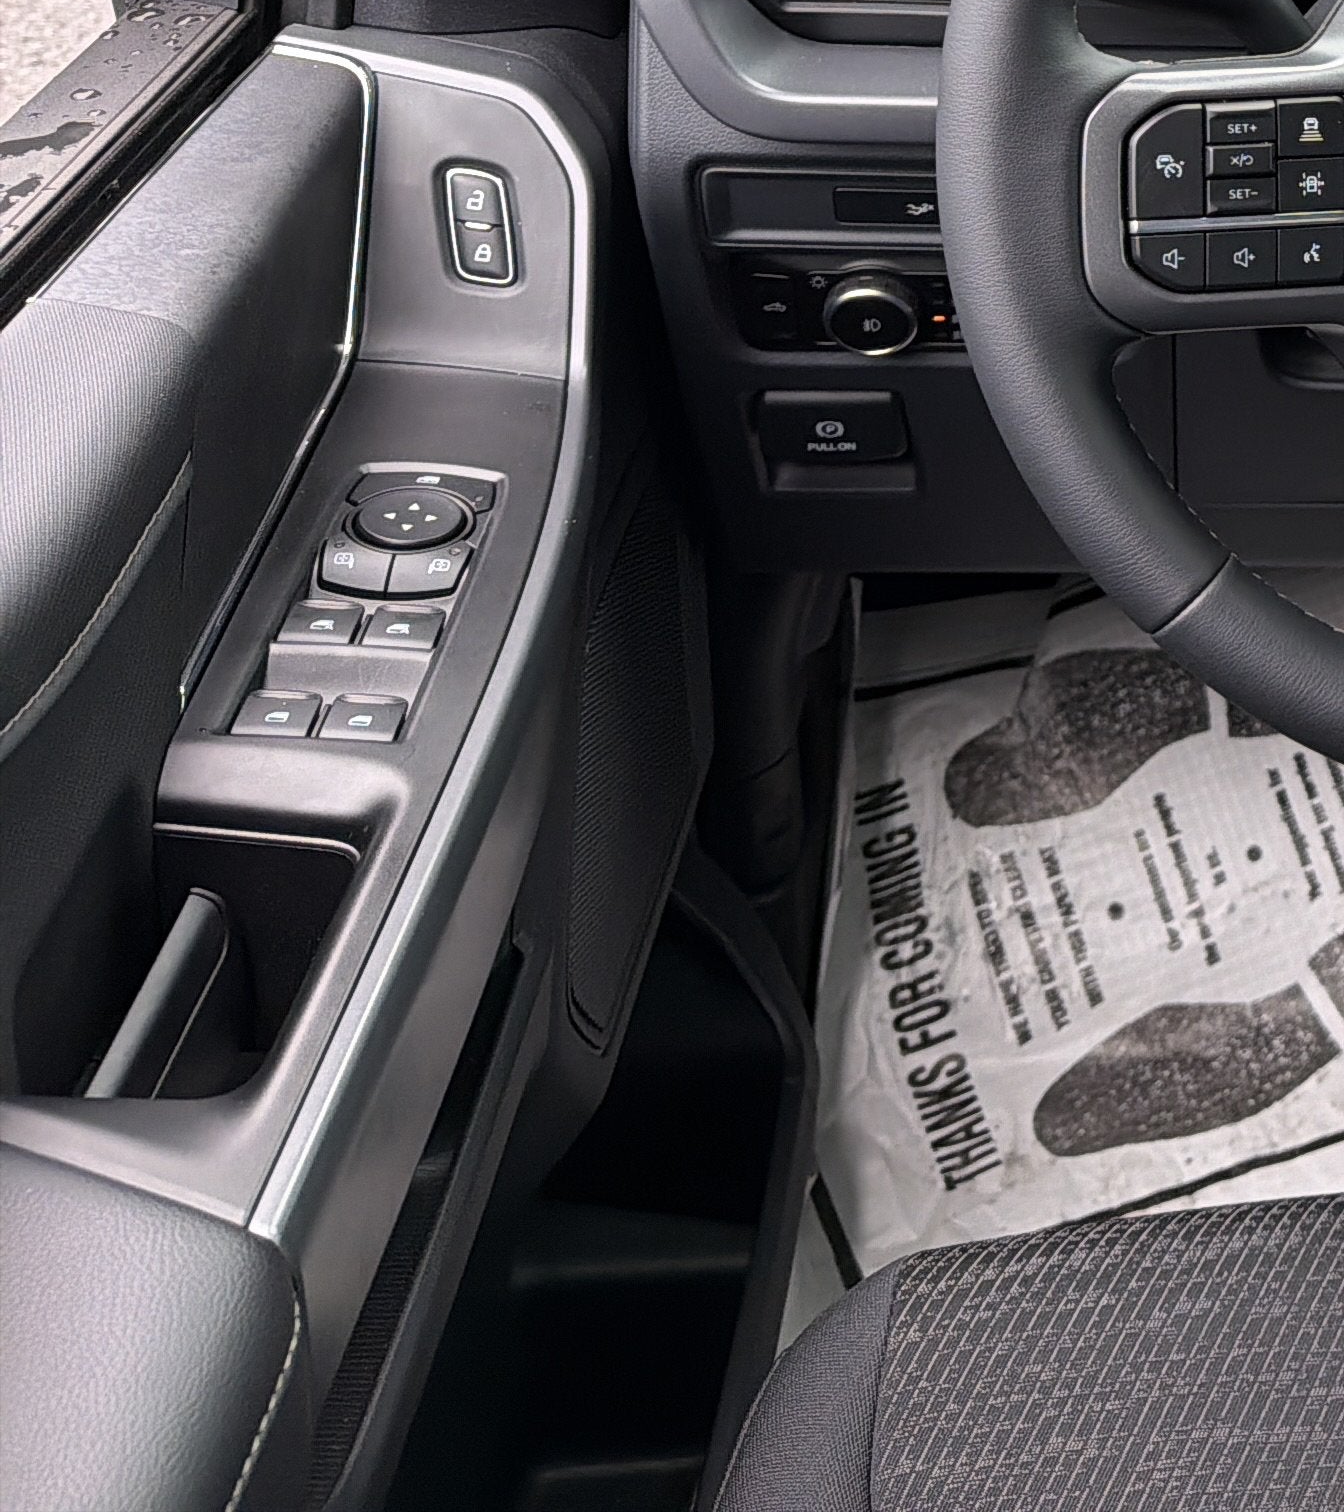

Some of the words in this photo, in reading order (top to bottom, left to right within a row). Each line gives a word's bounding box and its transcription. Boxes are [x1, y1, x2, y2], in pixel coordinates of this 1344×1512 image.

[1227, 122, 1258, 135] SET+
[807, 442, 836, 453] PULL
[836, 441, 857, 452] ON
[1266, 766, 1283, 788] for
[854, 777, 911, 827] IN
[1152, 791, 1183, 838] people
[1275, 787, 1313, 868] suggestions
[1000, 850, 1029, 902] CLEAN
[1038, 845, 1062, 879] MAT
[1168, 838, 1200, 905] important
[1304, 868, 1323, 902] Your
[861, 823, 934, 972] COMING
[976, 908, 996, 931] TO
[1050, 877, 1080, 929] PAPER
[1067, 927, 1089, 966] THIS
[999, 974, 1025, 1018] HAVE
[1044, 986, 1071, 1032] YOUR
[1078, 963, 1105, 1009] WITH
[888, 969, 958, 1057] FOR
[1012, 1016, 1033, 1047] WE
[907, 1052, 1003, 1192] THANKS
